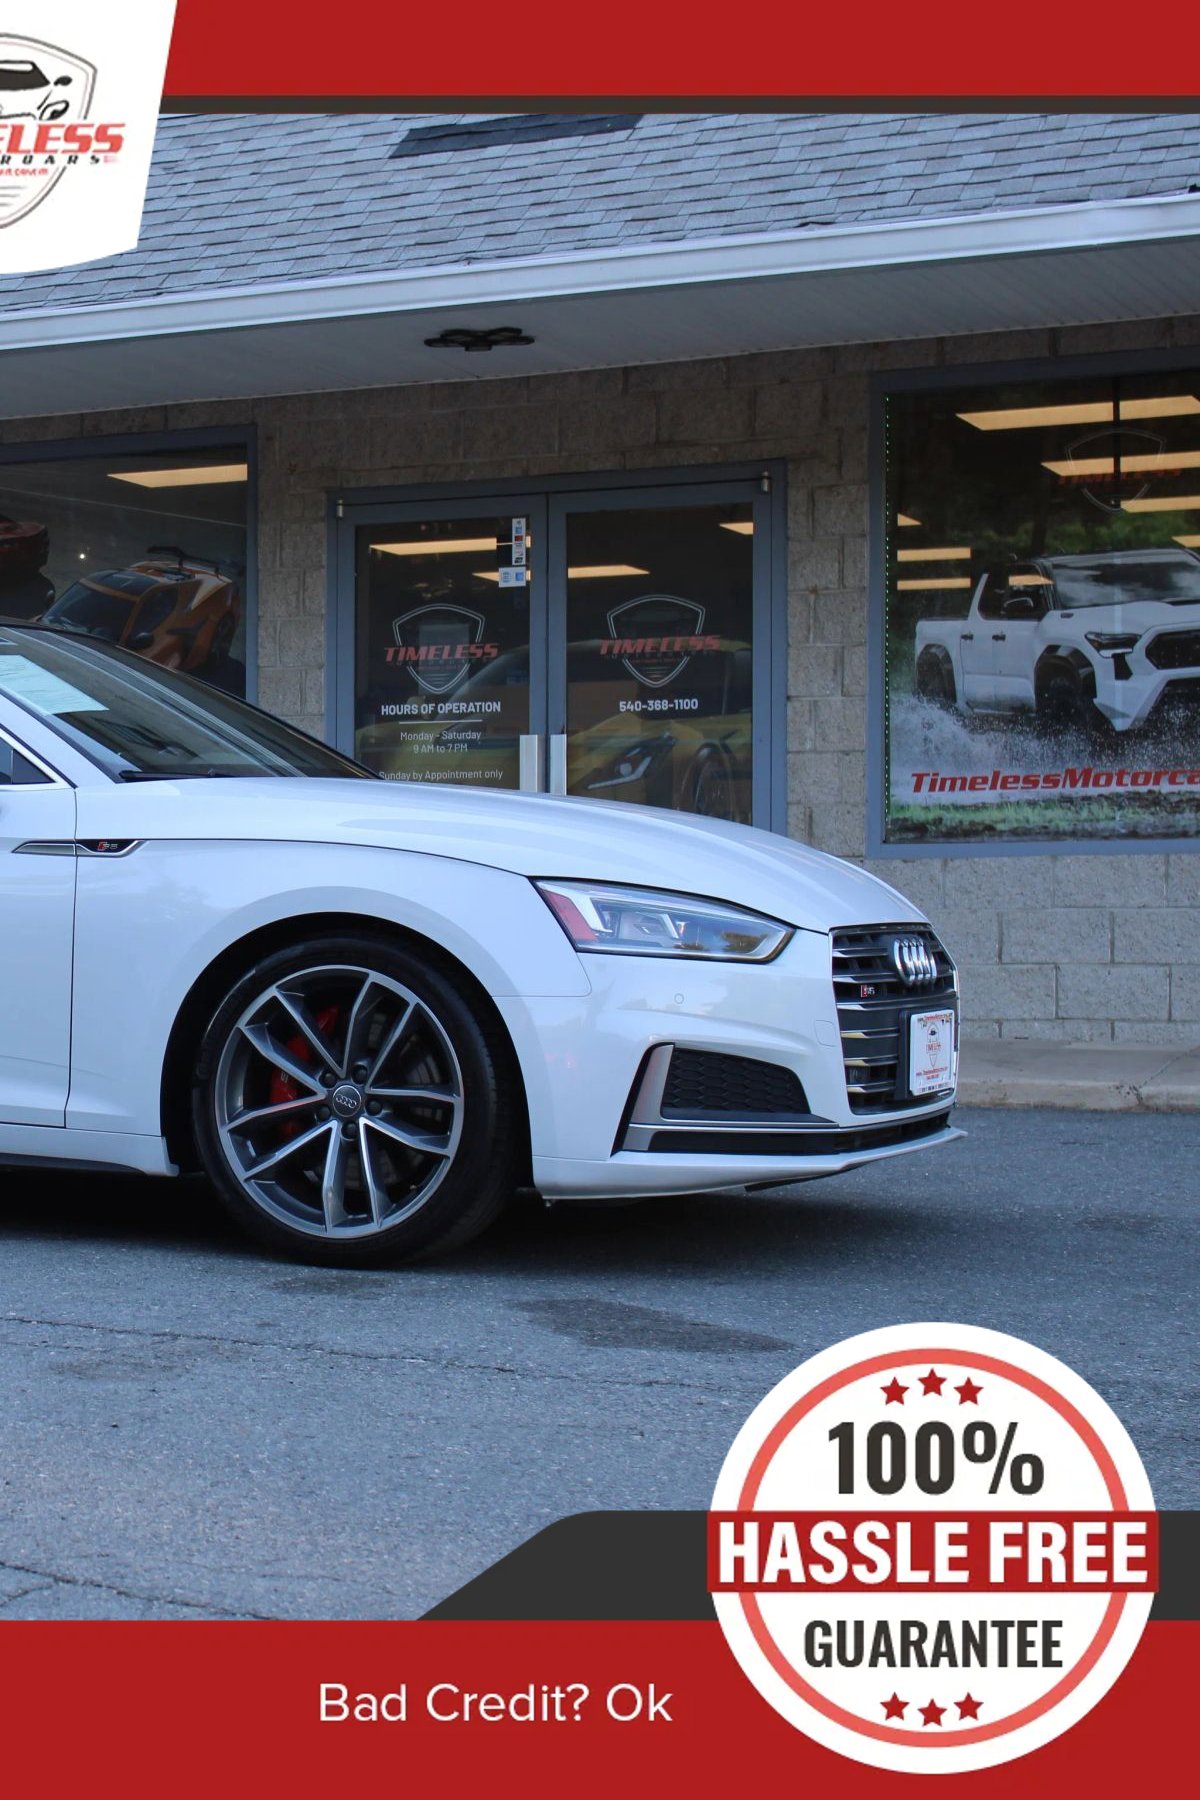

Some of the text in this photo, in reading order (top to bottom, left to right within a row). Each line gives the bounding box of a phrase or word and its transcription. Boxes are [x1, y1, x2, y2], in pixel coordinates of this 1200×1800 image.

[600, 634, 721, 656] TIMELESS
[384, 643, 499, 662] TIMELESS
[381, 701, 501, 716] HOURS OF OPERATION
[619, 698, 699, 712] 540-368-1100
[400, 731, 434, 742] Monday
[441, 730, 481, 741] Saturday
[413, 744, 419, 753] 9
[421, 744, 434, 753] AM
[436, 744, 446, 753] to
[454, 743, 468, 752] PM
[413, 771, 422, 780] by
[425, 770, 482, 781] Appointment
[484, 769, 503, 779] only
